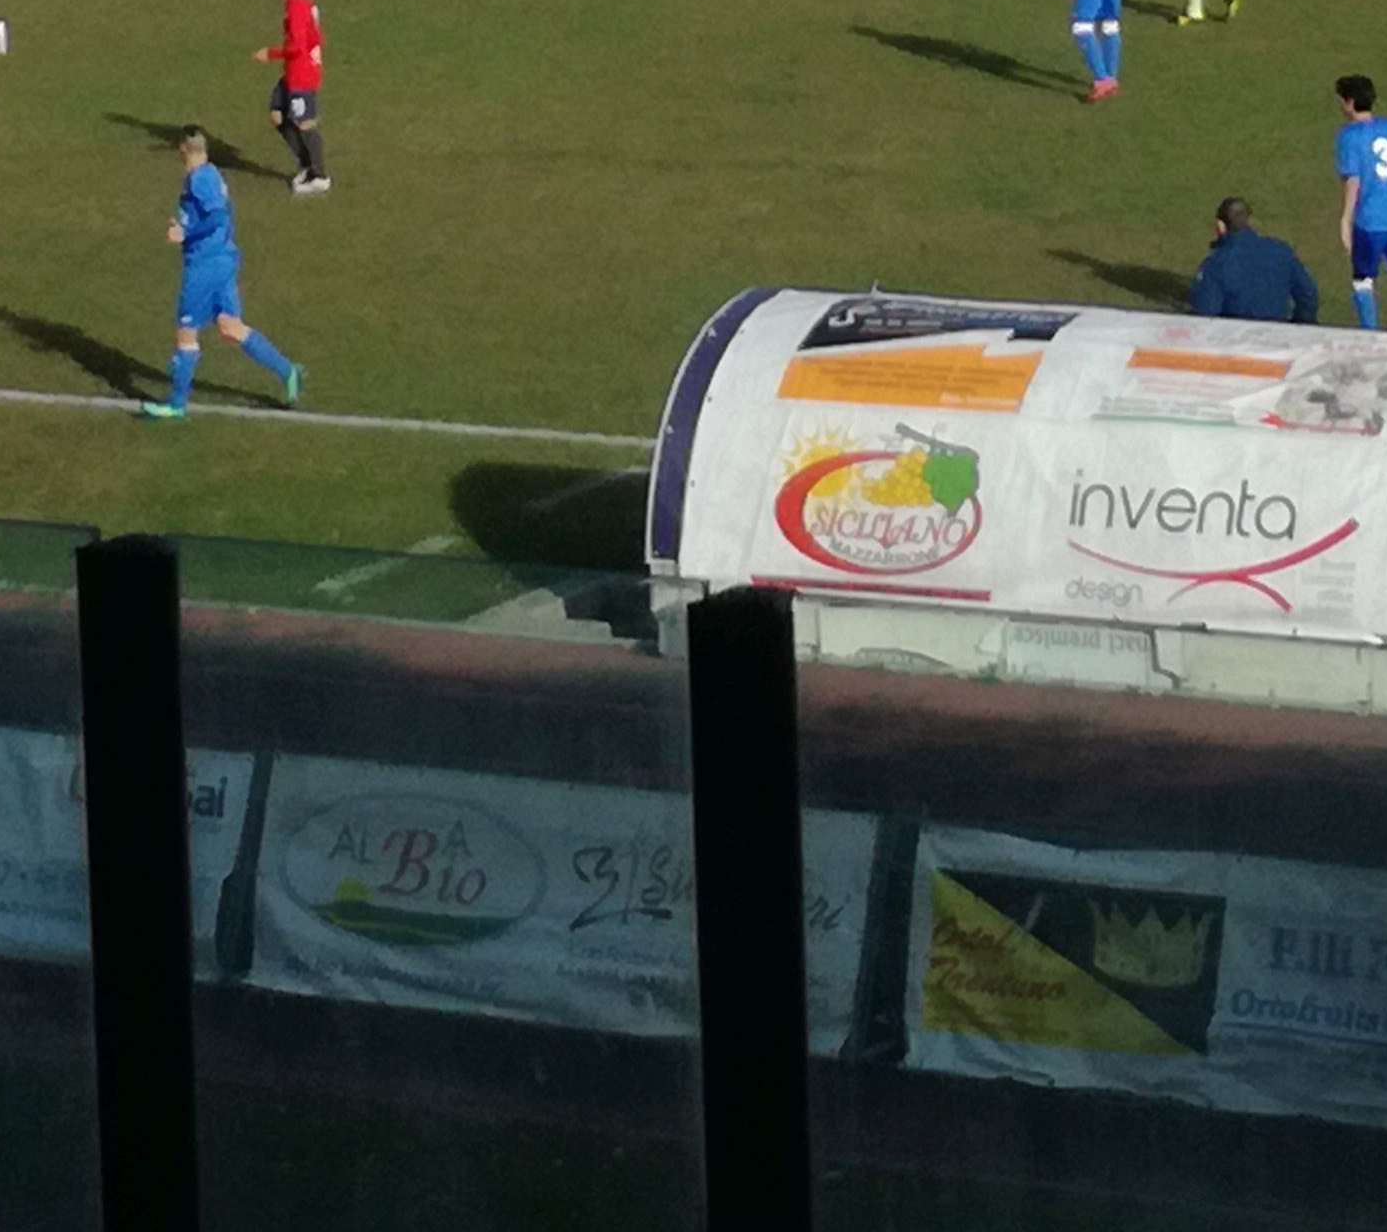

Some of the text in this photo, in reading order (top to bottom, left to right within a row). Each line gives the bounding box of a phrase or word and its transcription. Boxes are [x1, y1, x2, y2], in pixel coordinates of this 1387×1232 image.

[811, 503, 967, 548] SICILIANO
[1068, 469, 1297, 541] inventa
[1064, 575, 1143, 607] design
